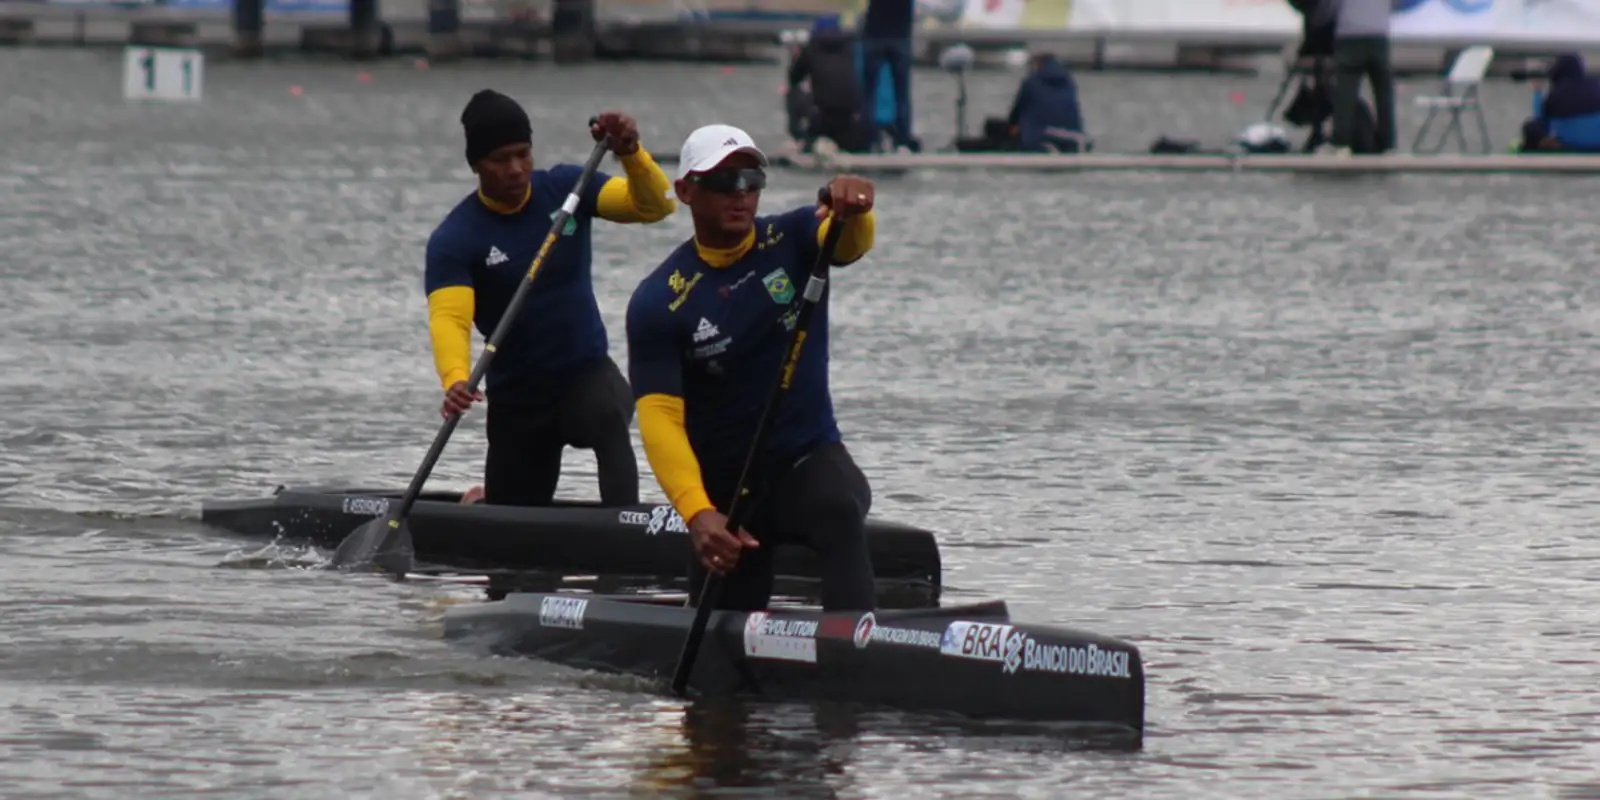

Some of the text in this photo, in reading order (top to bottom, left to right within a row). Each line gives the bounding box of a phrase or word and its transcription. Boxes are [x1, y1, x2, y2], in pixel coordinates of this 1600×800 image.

[762, 619, 819, 637] EVOLUTION
[962, 624, 1002, 658] BRA
[1024, 638, 1132, 679] BANCO DO BRASIL
